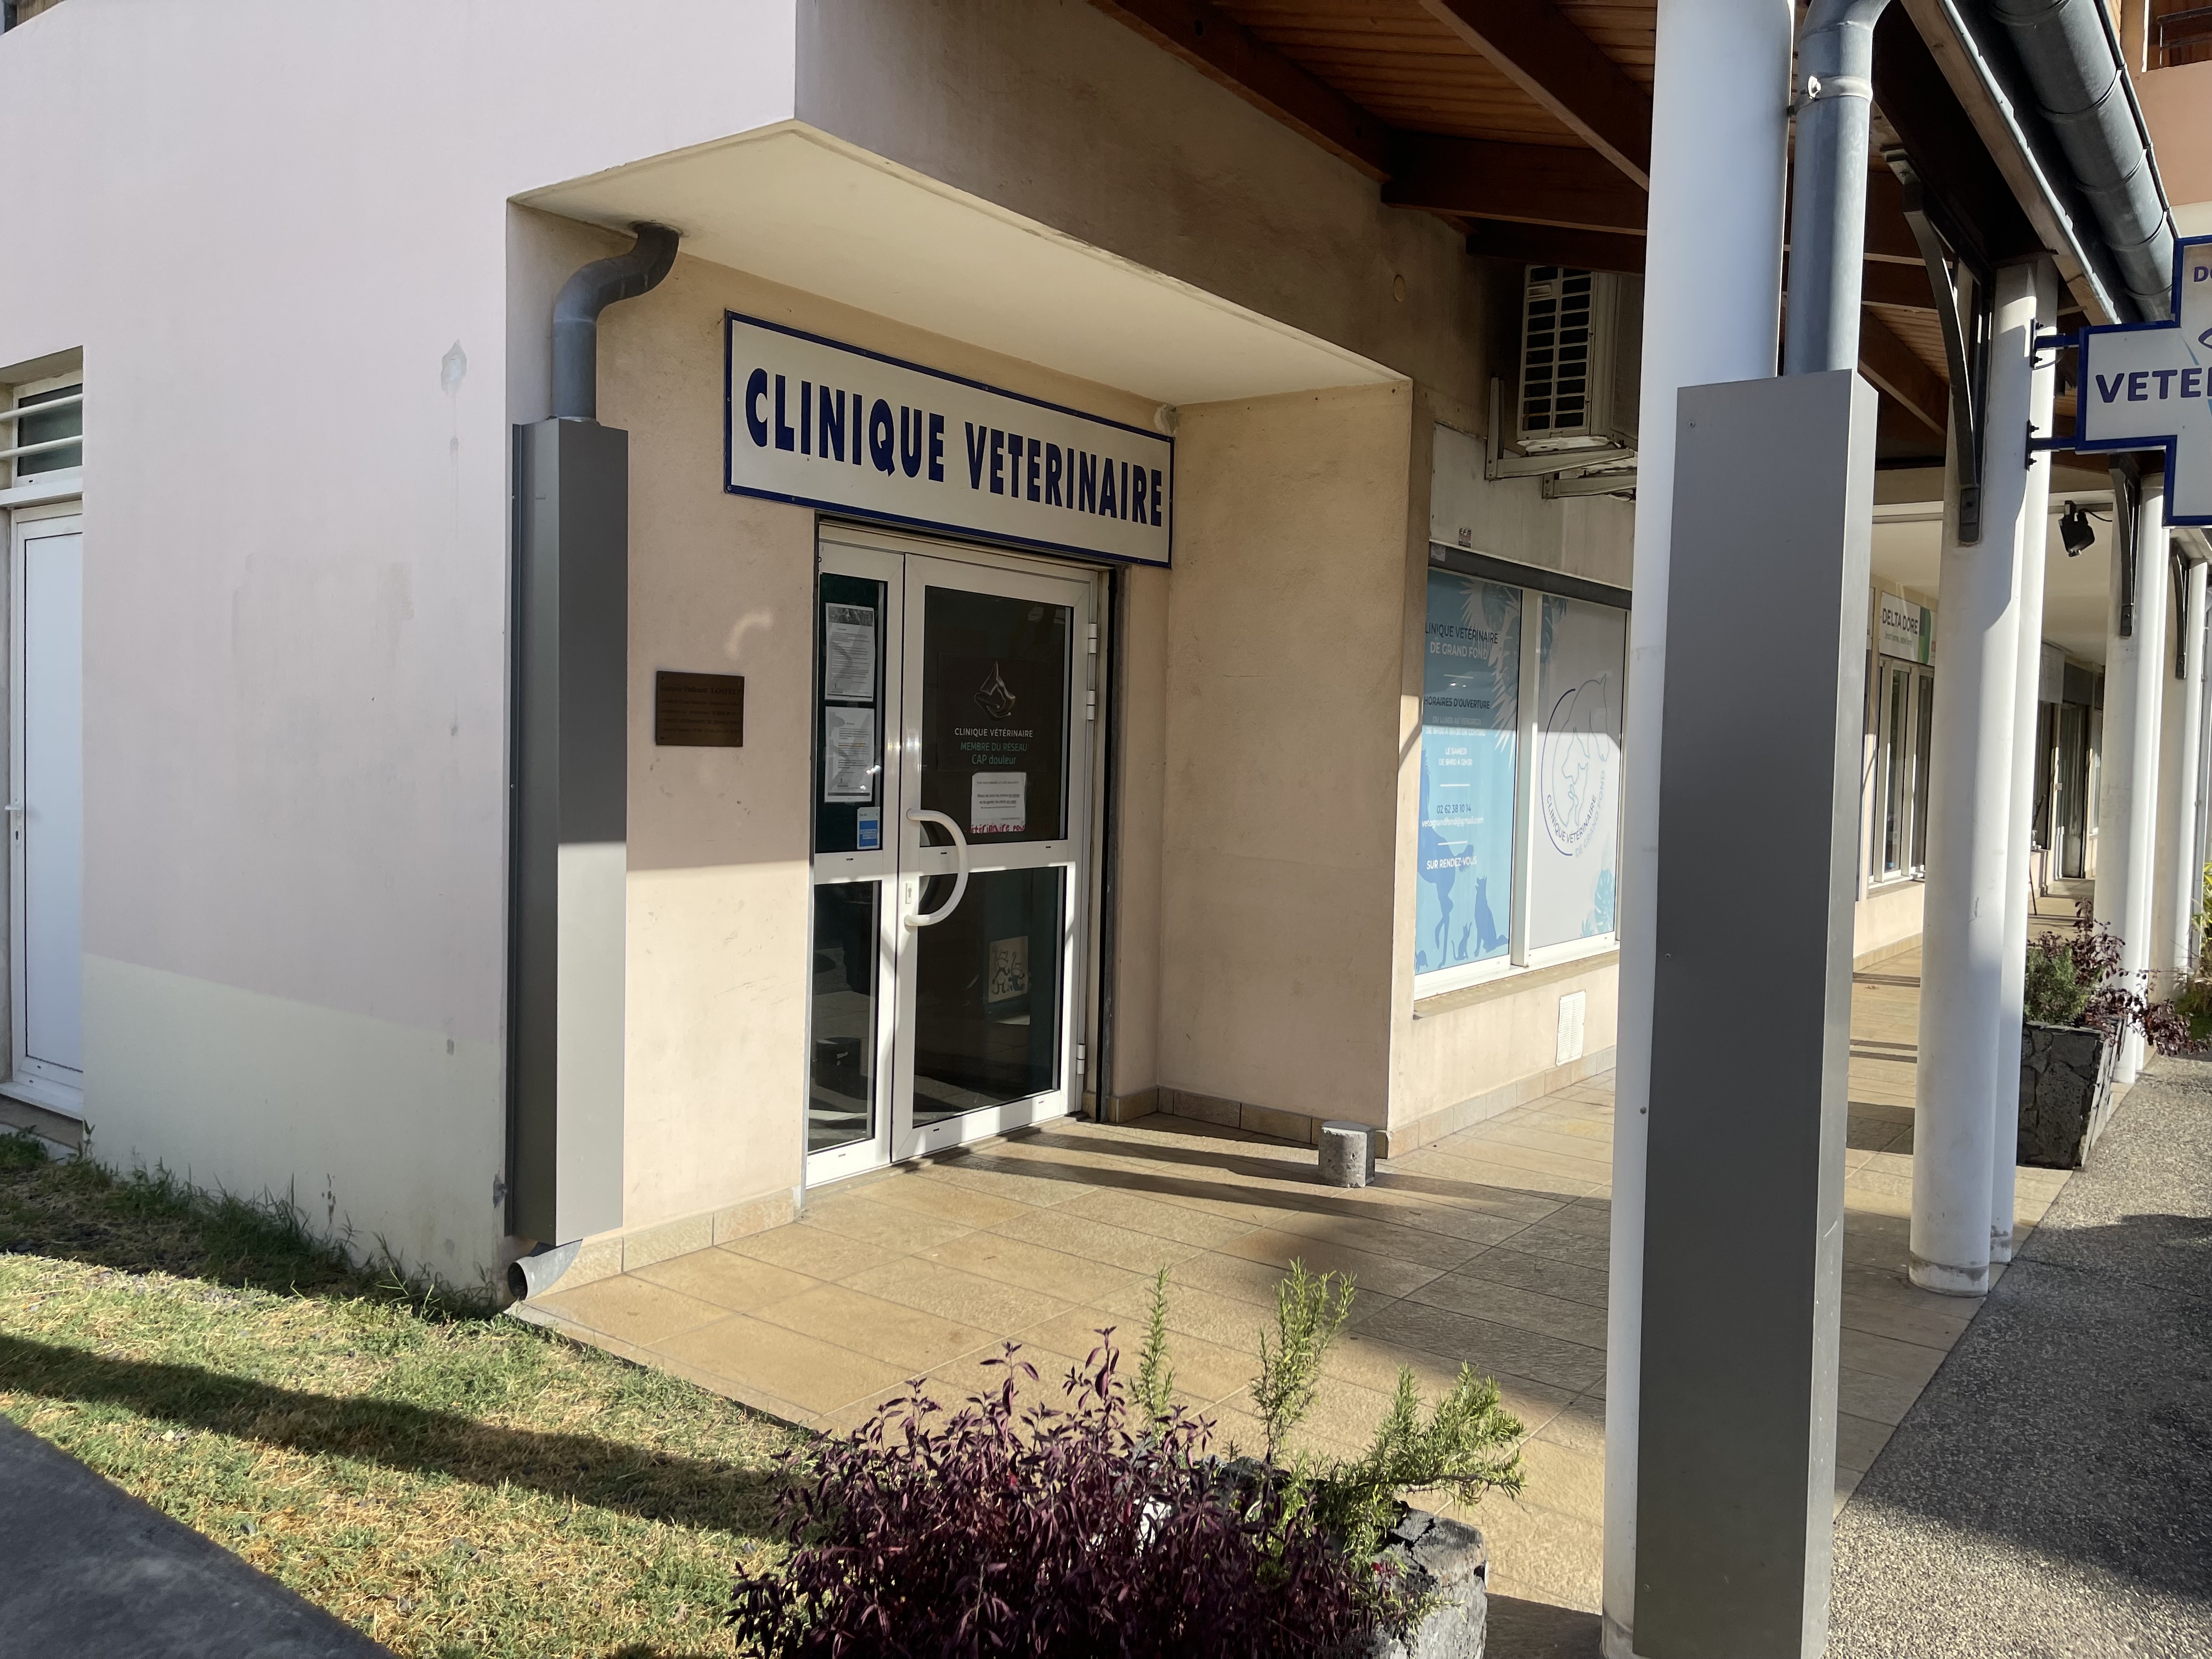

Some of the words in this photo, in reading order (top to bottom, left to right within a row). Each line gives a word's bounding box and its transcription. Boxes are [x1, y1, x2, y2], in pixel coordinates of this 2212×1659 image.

[746, 368, 945, 483] CLINIQUE
[964, 421, 1162, 527] VETERINAIRE
[1882, 608, 1901, 629] DELTA
[1903, 616, 1918, 634] DORE
[1425, 622, 1454, 638] LINIQUE
[1455, 624, 1498, 644] VÉTÉRINAIRE
[1430, 641, 1441, 654] DE
[1442, 644, 1468, 657] GRAND
[1469, 646, 1488, 660] FOND
[1424, 696, 1453, 707] HORAIRES
[1454, 698, 1490, 709] D'OUVERTURE
[954, 727, 988, 737] CLINIQUE
[990, 727, 1033, 738] VÉTÉRINAIRE
[960, 742, 990, 751] MEMBRE
[991, 742, 1001, 751] DU
[1003, 741, 1028, 752] RÉSEAU
[972, 754, 987, 764] CAP
[989, 754, 1016, 764] douleur
[1437, 805, 1443, 814] 02
[1444, 804, 1451, 813] 62
[1452, 804, 1458, 812] 38
[1459, 804, 1465, 812] 10
[1466, 804, 1471, 812] 14
[1575, 843, 1583, 857] DE
[1583, 811, 1599, 848] GRAND
[1597, 770, 1605, 809] FOND
[1547, 794, 1566, 842] CLINIQUE
[1566, 794, 1596, 843] VÉTÉRINAIRE
[1426, 860, 1438, 870] SUR
[1439, 856, 1477, 868] RENDEZ-VOUS
